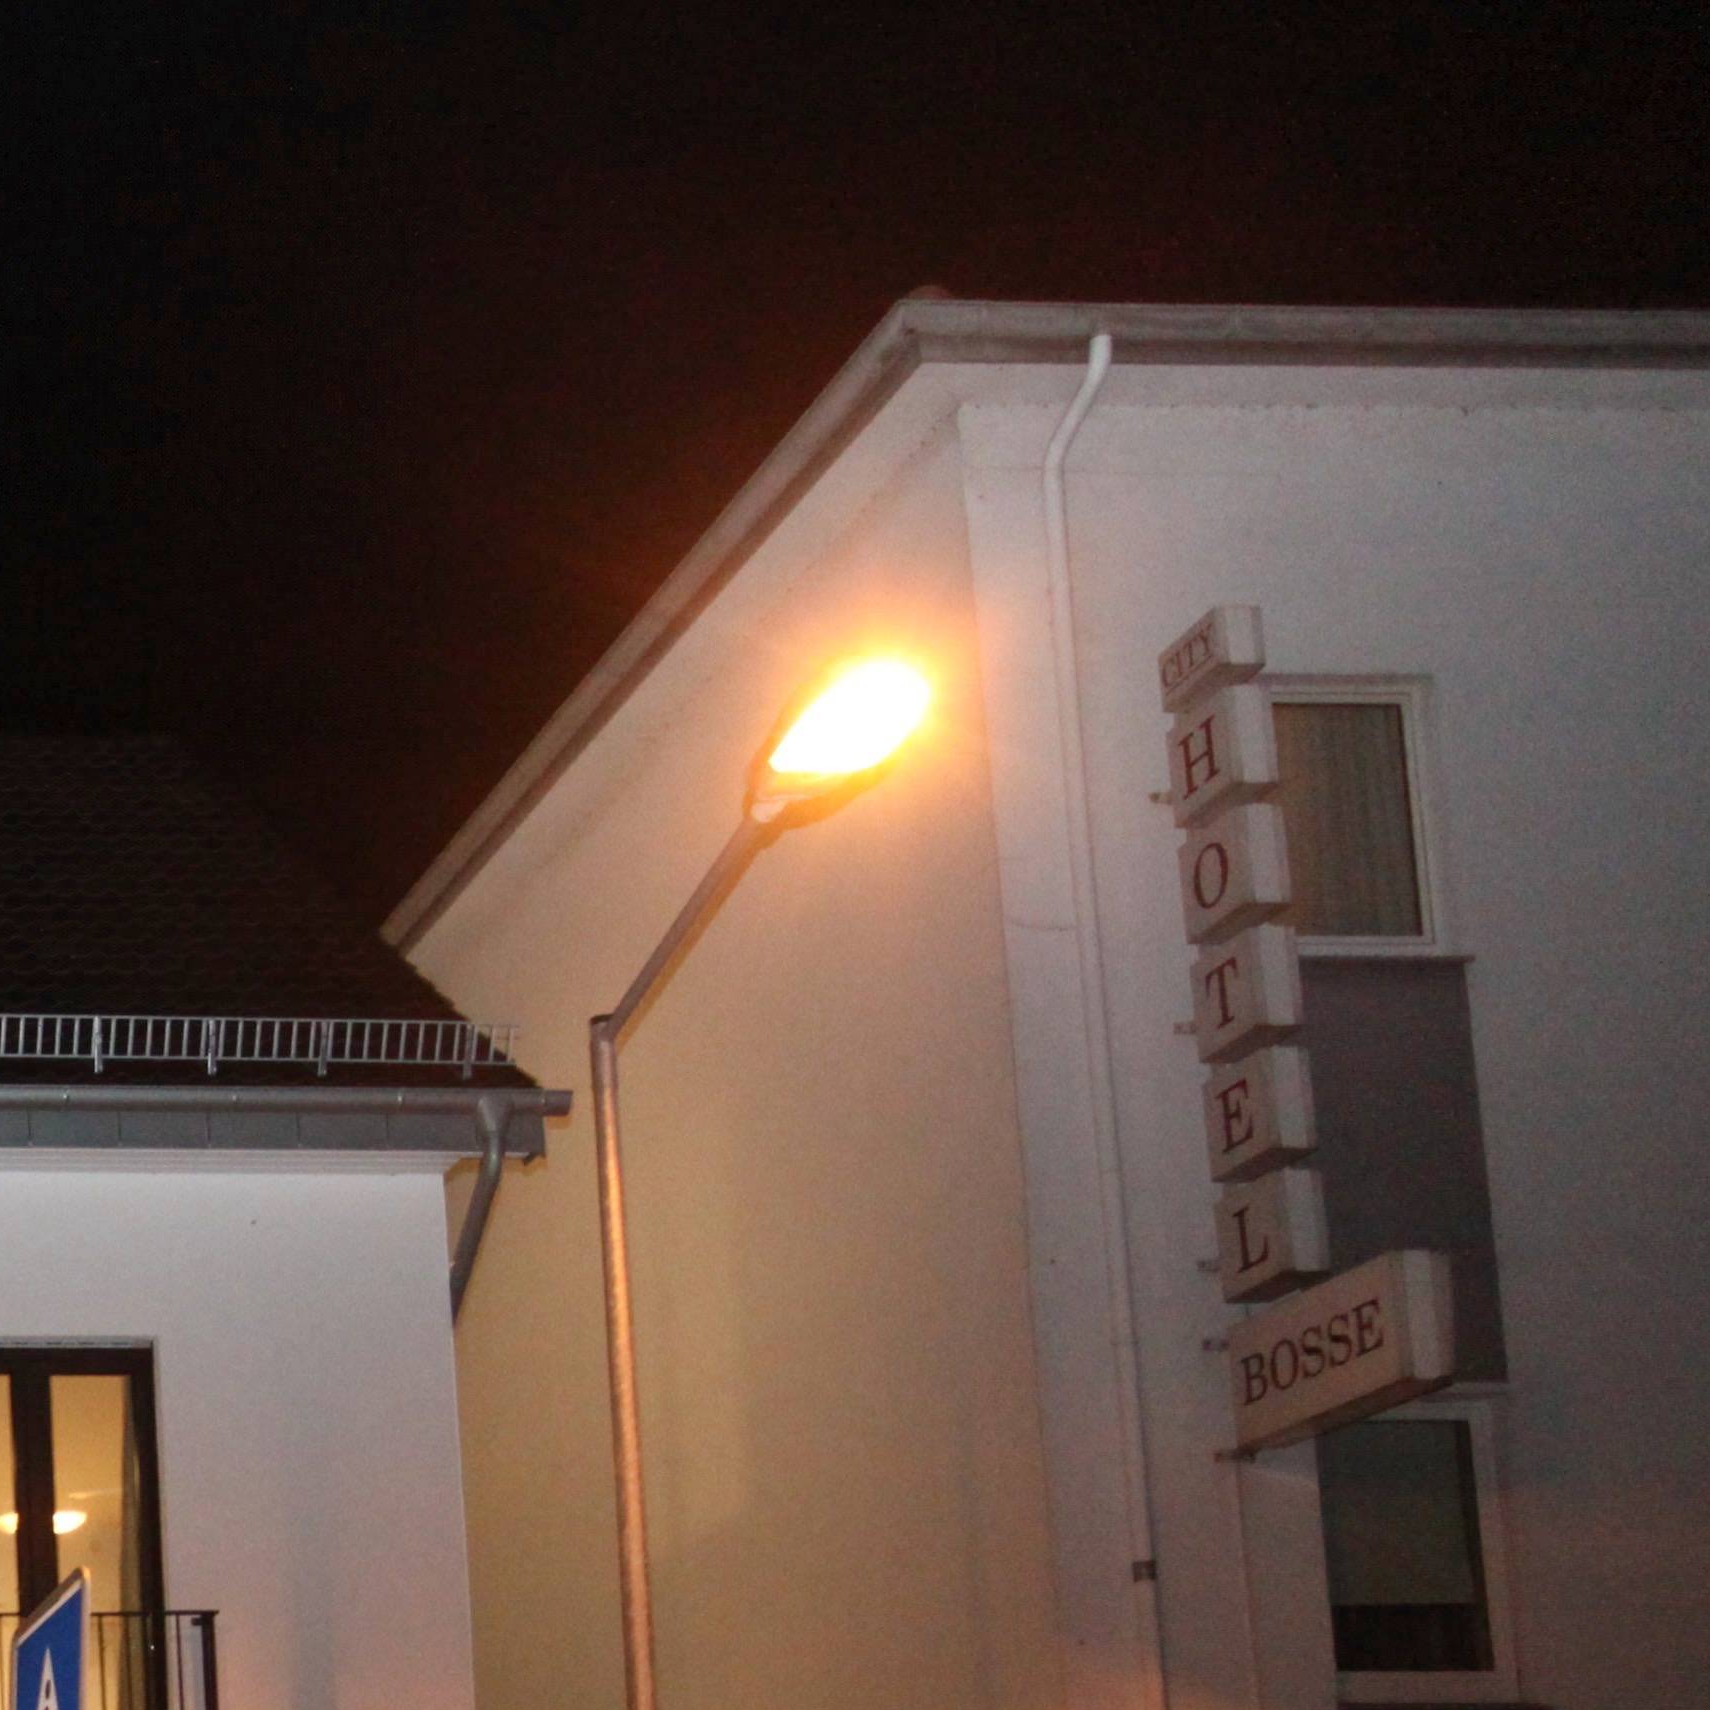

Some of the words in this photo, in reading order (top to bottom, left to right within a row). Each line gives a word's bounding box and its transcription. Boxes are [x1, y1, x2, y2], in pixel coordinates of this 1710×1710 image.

[1161, 622, 1213, 688] CITY
[1178, 714, 1271, 1275] HOTEL
[1240, 1299, 1385, 1407] BOSSE
